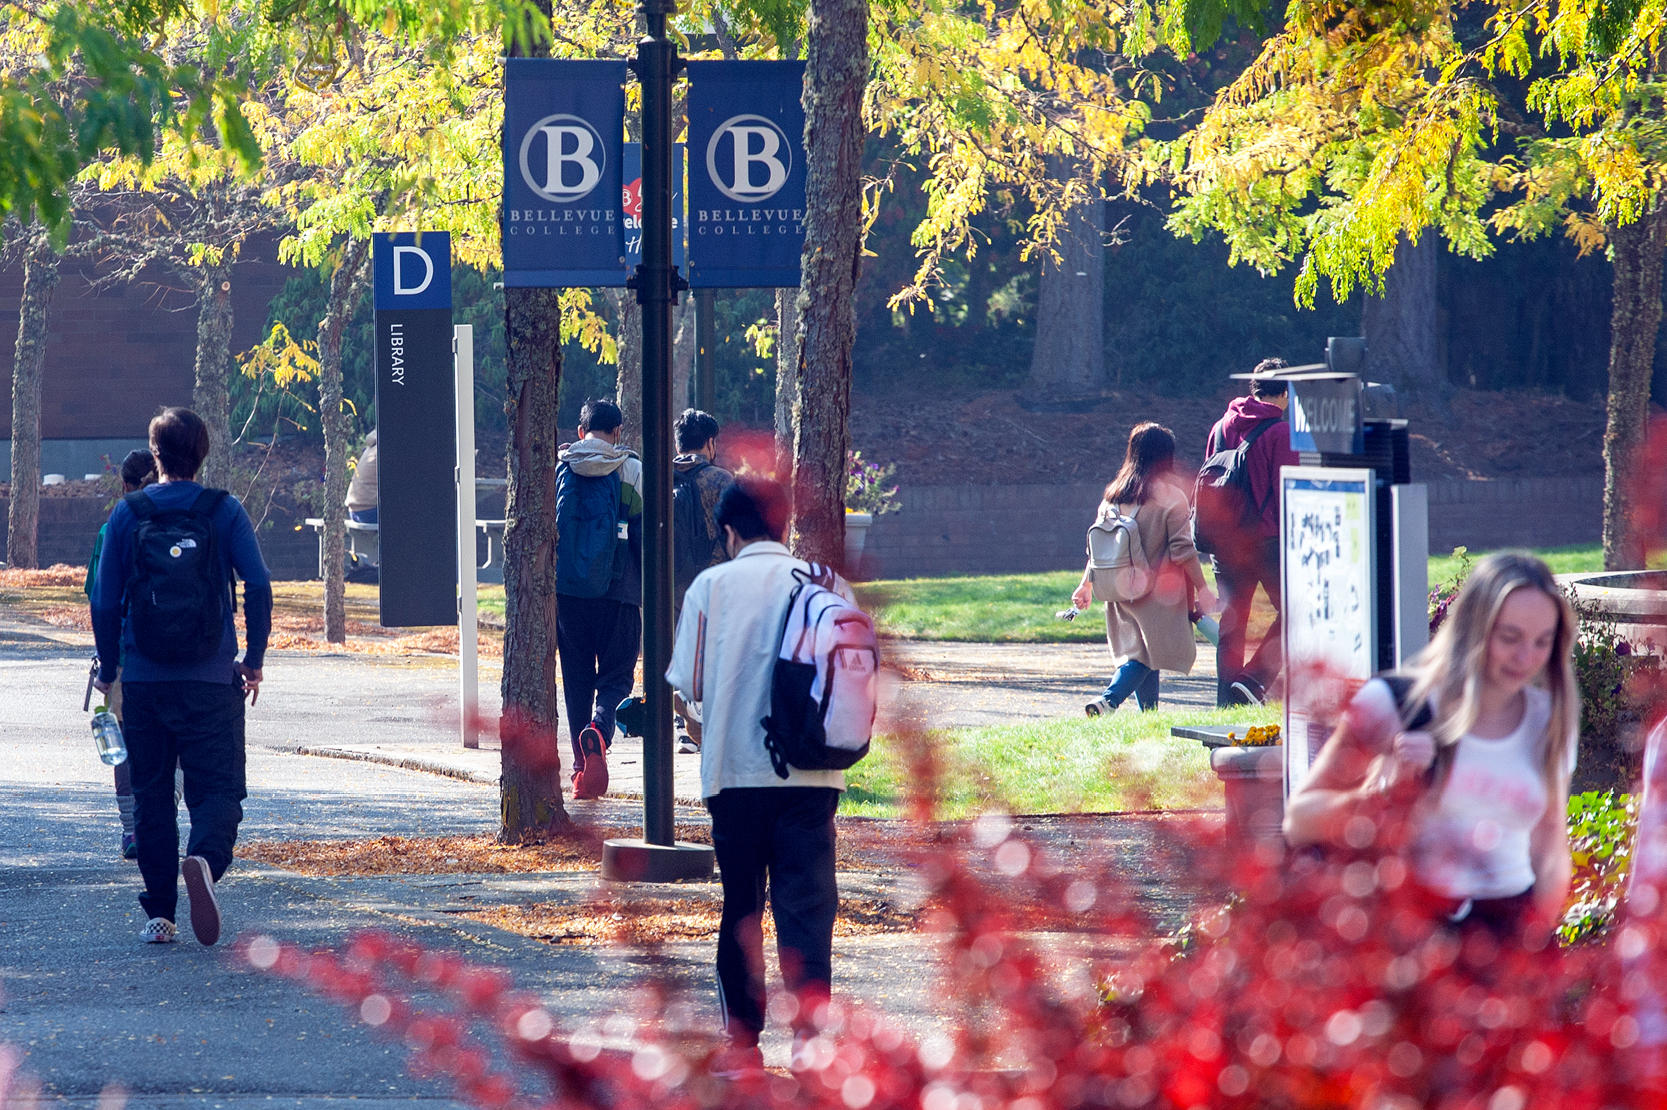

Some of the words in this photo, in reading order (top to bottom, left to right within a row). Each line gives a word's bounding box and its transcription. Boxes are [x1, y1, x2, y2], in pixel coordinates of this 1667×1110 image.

[539, 126, 600, 193] B
[725, 126, 786, 193] B
[510, 209, 615, 221] BELLEVUE
[698, 209, 802, 221] BELLEVUE
[698, 225, 803, 235] COLLEGE
[510, 226, 615, 235] COLLEGE
[393, 246, 434, 295] D
[390, 323, 405, 386] LIBRARY
